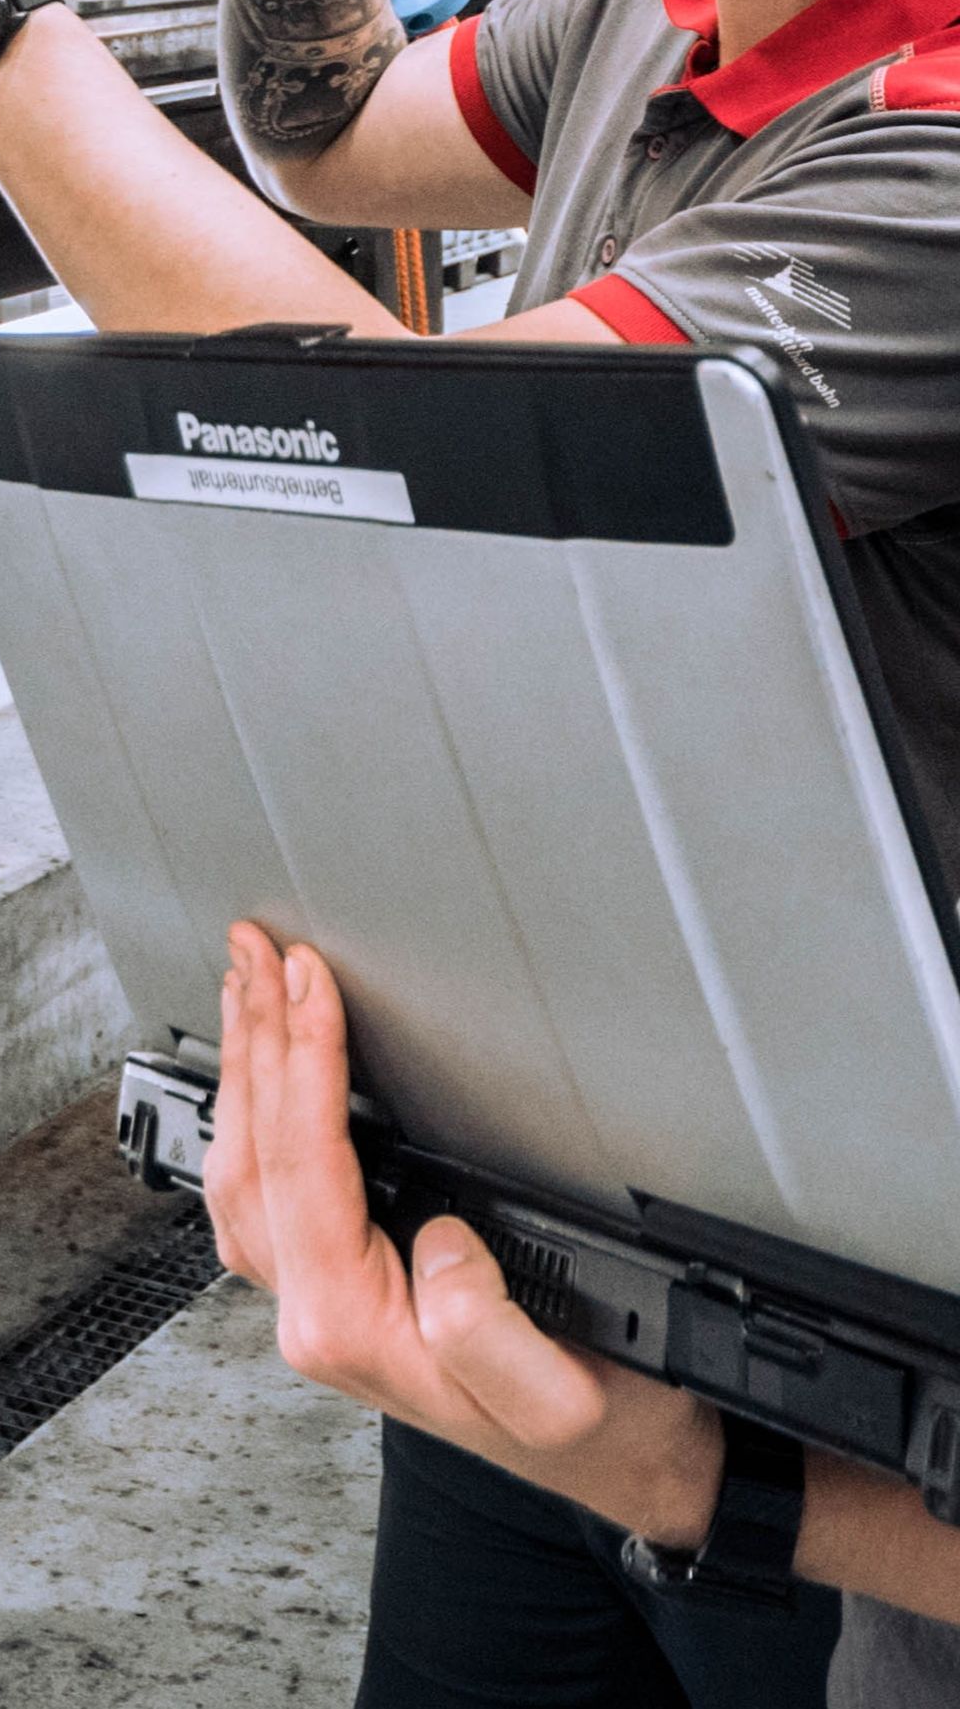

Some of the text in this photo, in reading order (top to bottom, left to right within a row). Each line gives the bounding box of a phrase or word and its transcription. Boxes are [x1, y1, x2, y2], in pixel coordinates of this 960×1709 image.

[809, 374, 840, 409] bahn
[176, 411, 340, 463] Panasonic
[188, 468, 344, 505] Betriebsunterhalt
